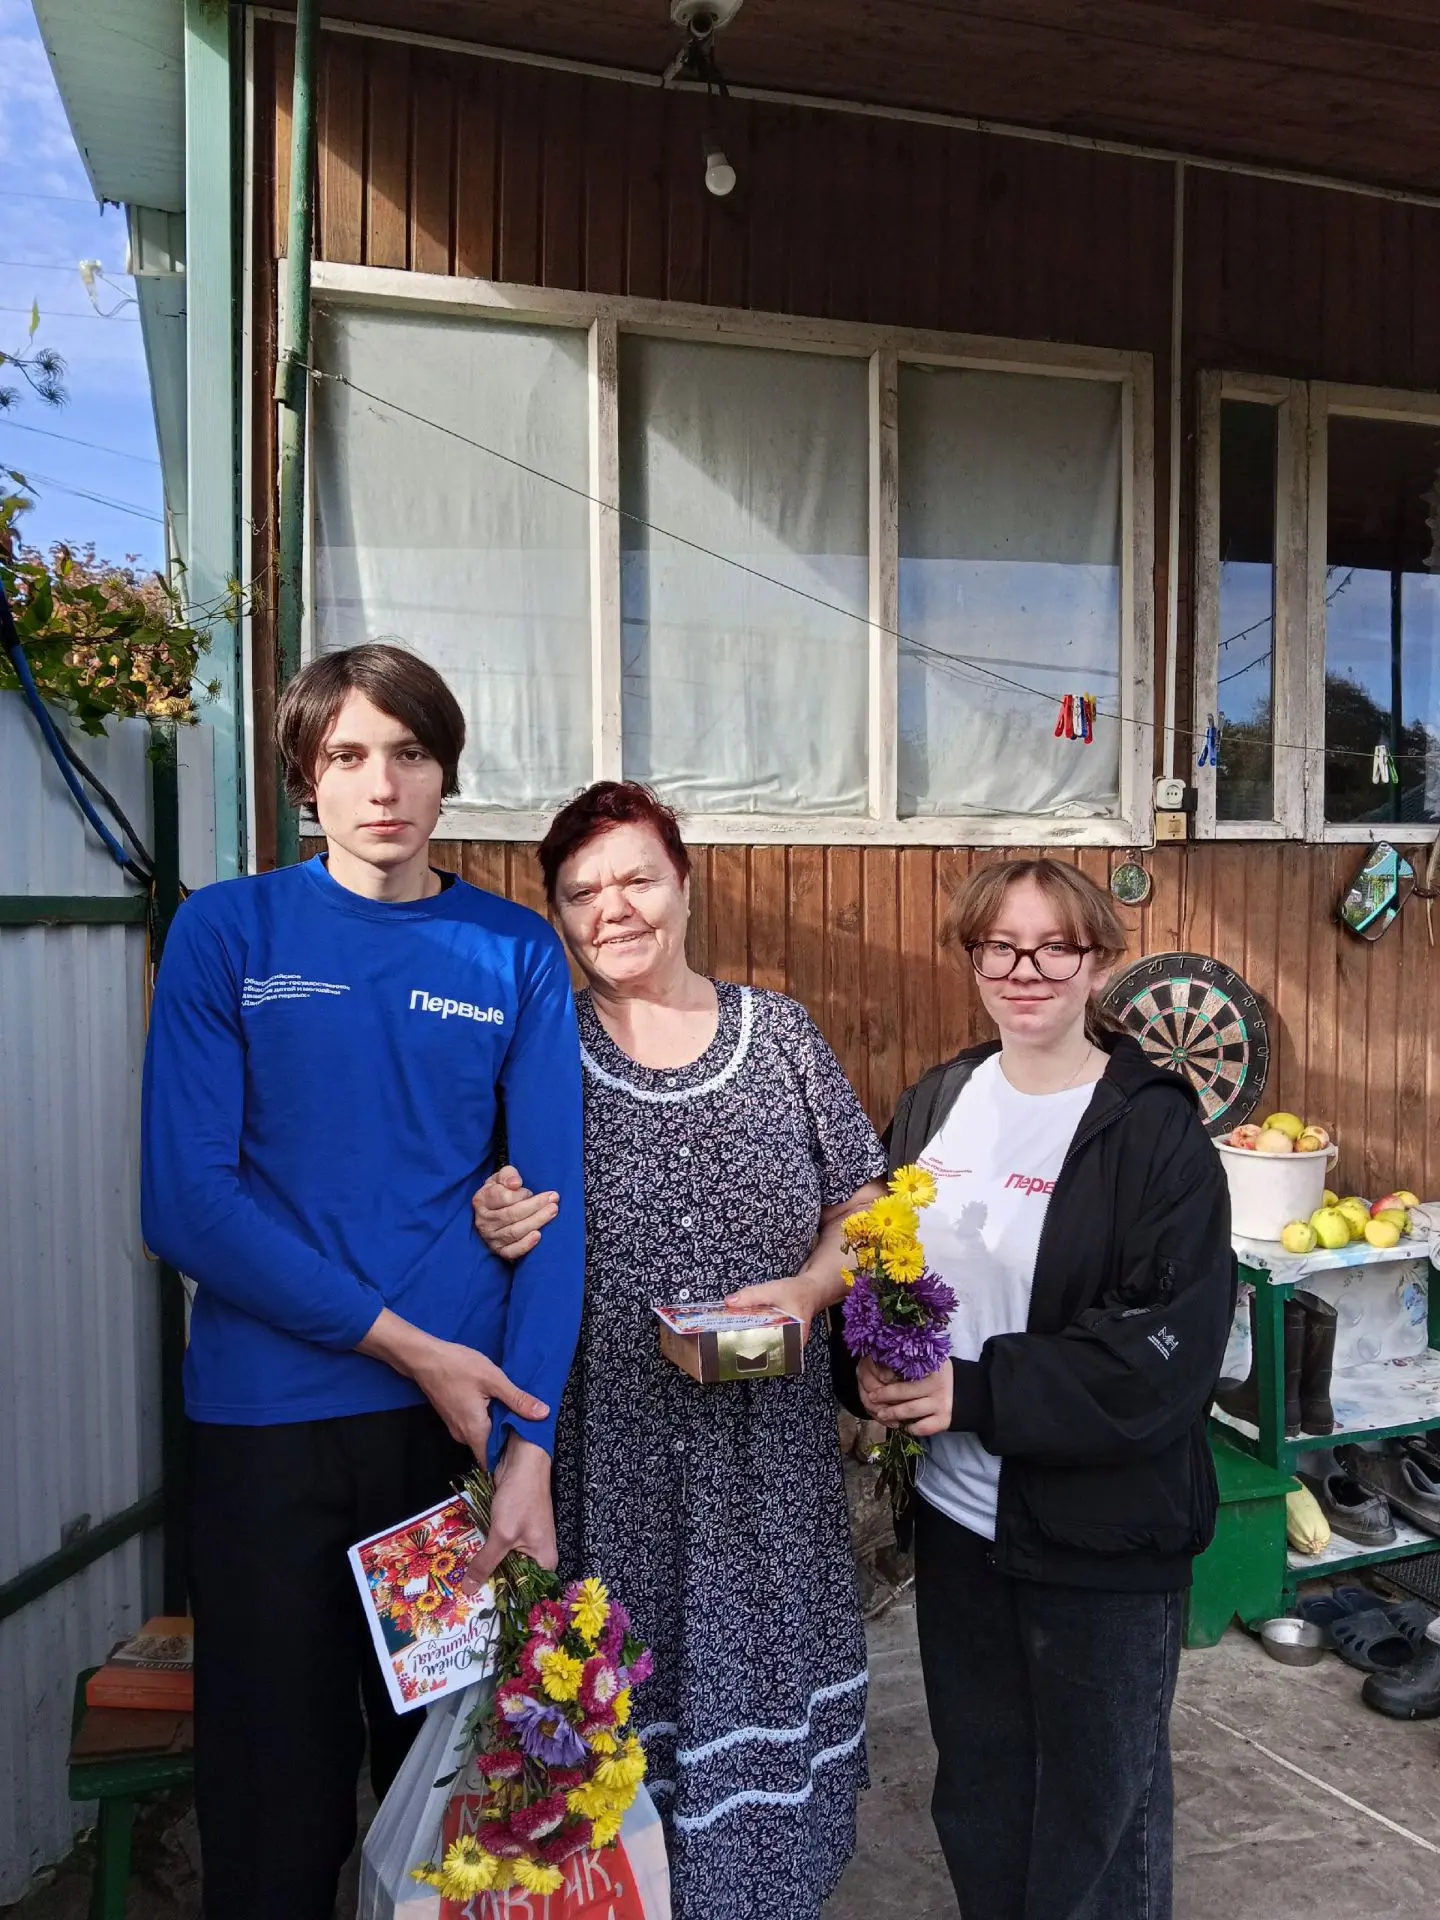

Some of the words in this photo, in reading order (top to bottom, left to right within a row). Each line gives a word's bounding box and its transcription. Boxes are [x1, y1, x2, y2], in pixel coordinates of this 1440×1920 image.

[410, 990, 504, 1025] Первые
[1148, 960, 1164, 974] 20
[1179, 956, 1185, 969] 1
[1202, 960, 1214, 973] 18
[1257, 1046, 1268, 1058] 10
[1004, 1173, 1057, 1196] Перв
[413, 1616, 490, 1673] учителя!
[422, 1646, 472, 1677] Днём
